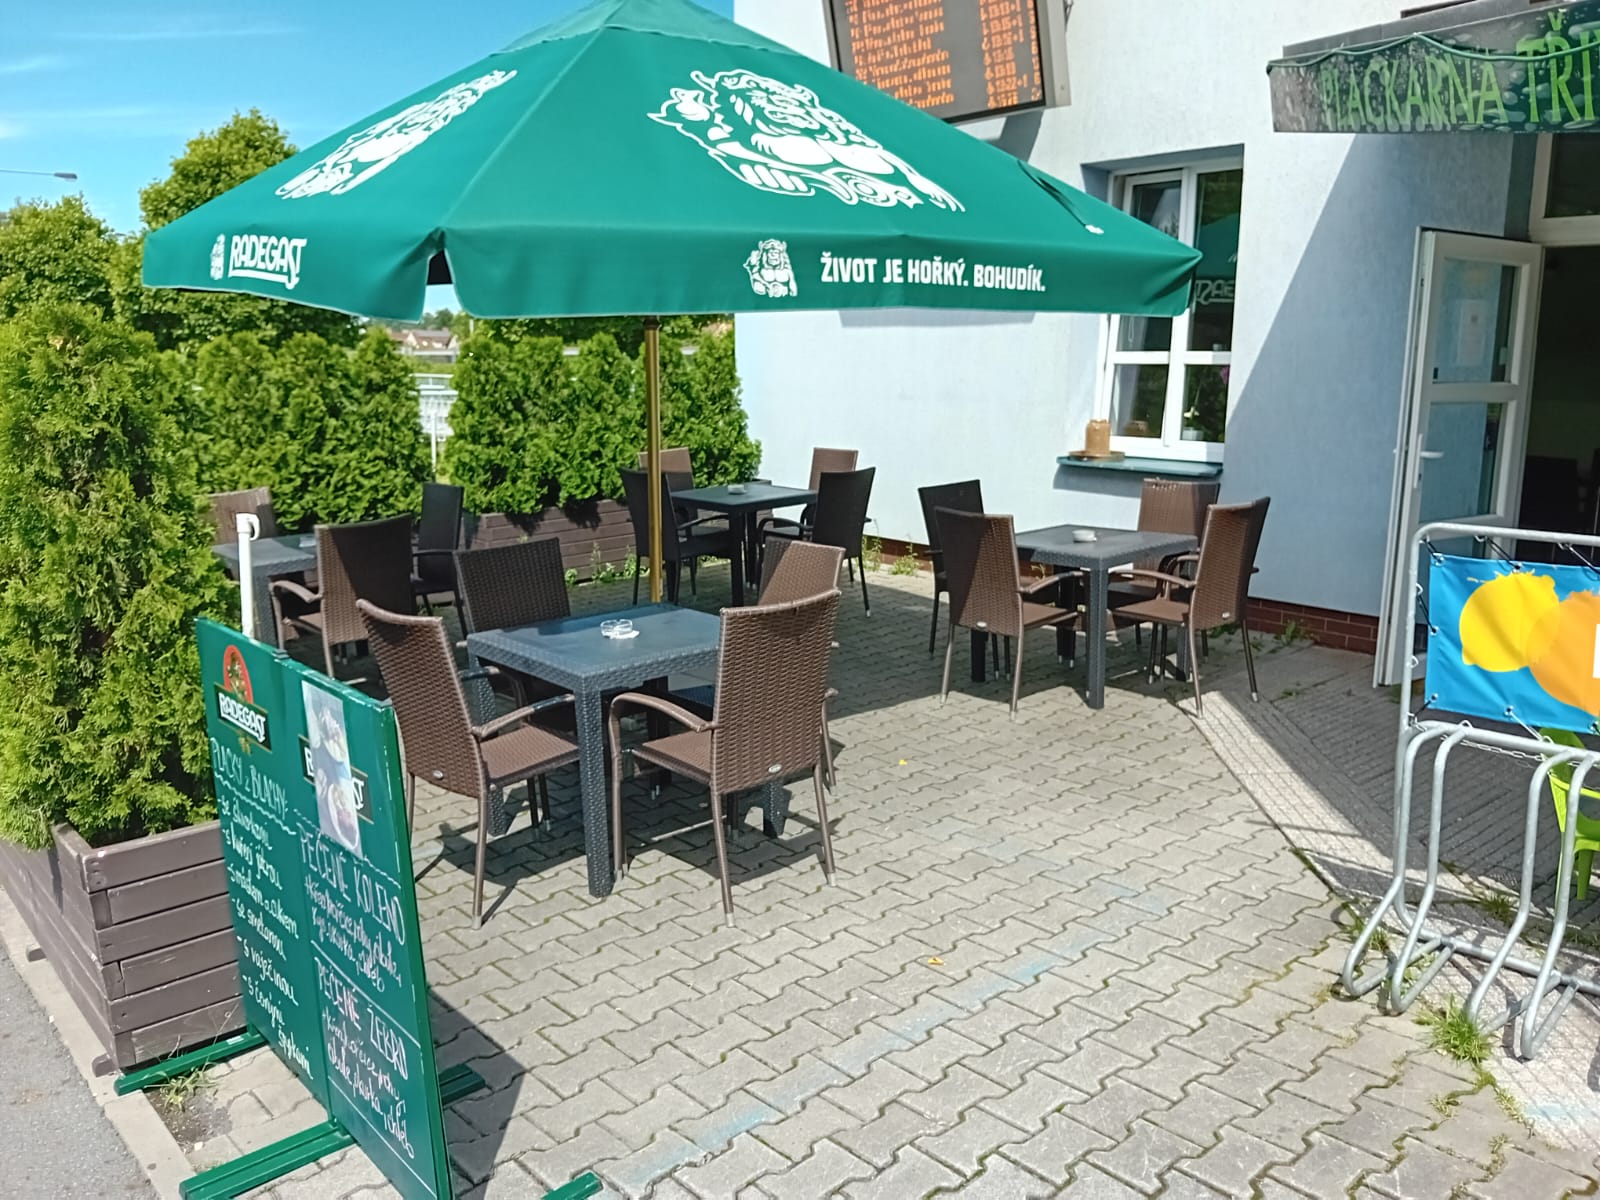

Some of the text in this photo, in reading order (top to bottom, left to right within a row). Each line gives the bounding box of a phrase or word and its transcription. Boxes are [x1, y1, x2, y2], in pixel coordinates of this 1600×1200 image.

[1516, 11, 1600, 122] TŘI
[228, 234, 307, 290] RADEGAST
[820, 252, 1046, 292] ŽIVOT JE HOŘKÝ. BOHUDÍK.
[218, 692, 267, 743] RADEGAST
